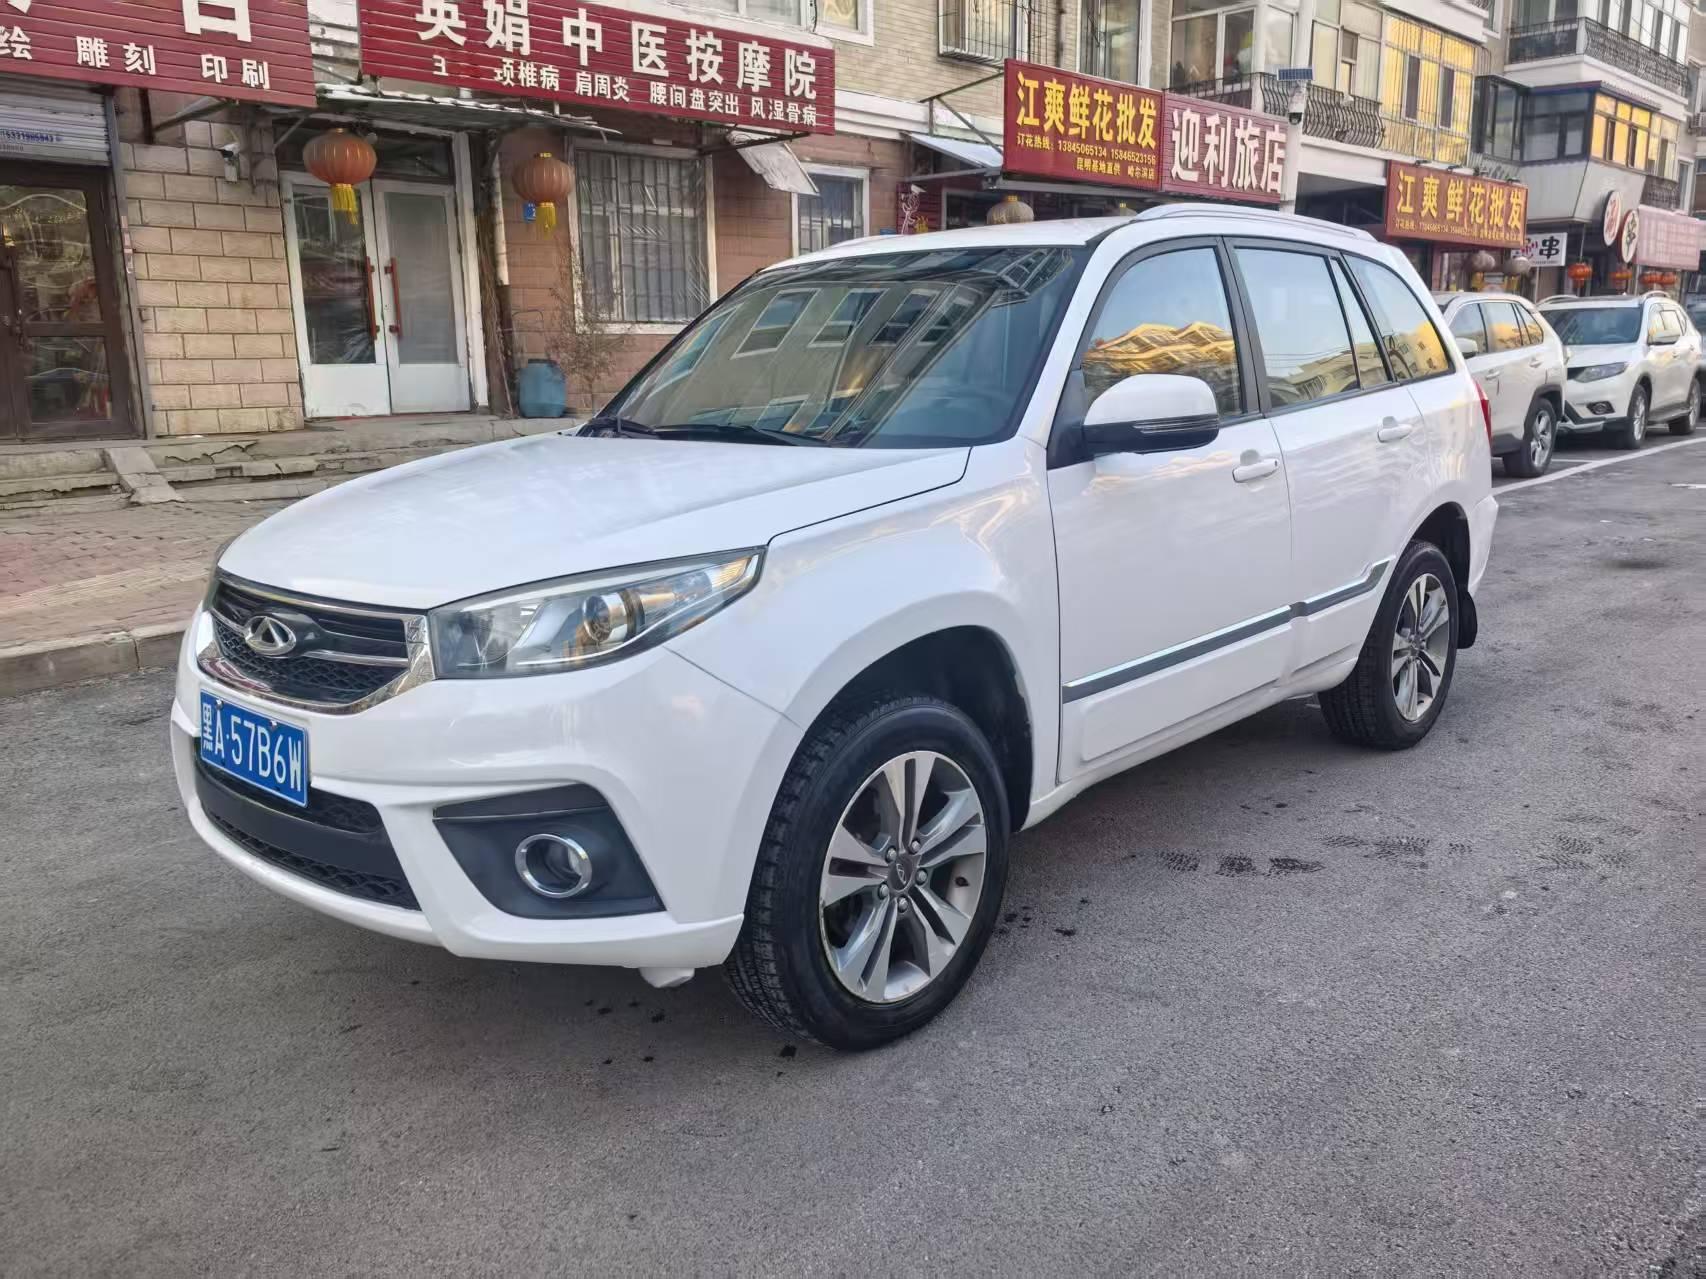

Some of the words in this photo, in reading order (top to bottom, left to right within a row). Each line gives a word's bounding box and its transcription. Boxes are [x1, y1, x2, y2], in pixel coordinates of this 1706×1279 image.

[76, 36, 156, 76] 雕刻
[201, 54, 270, 90] 印刷
[575, 72, 630, 102] 肩周炎
[650, 82, 740, 116] 腰间盘突出
[751, 97, 817, 127] 风湿骨病
[1016, 71, 1157, 150] 江爽鲜花批发
[1171, 108, 1287, 194] 迎利旅店
[1397, 170, 1523, 230] 江爽鲜花批发
